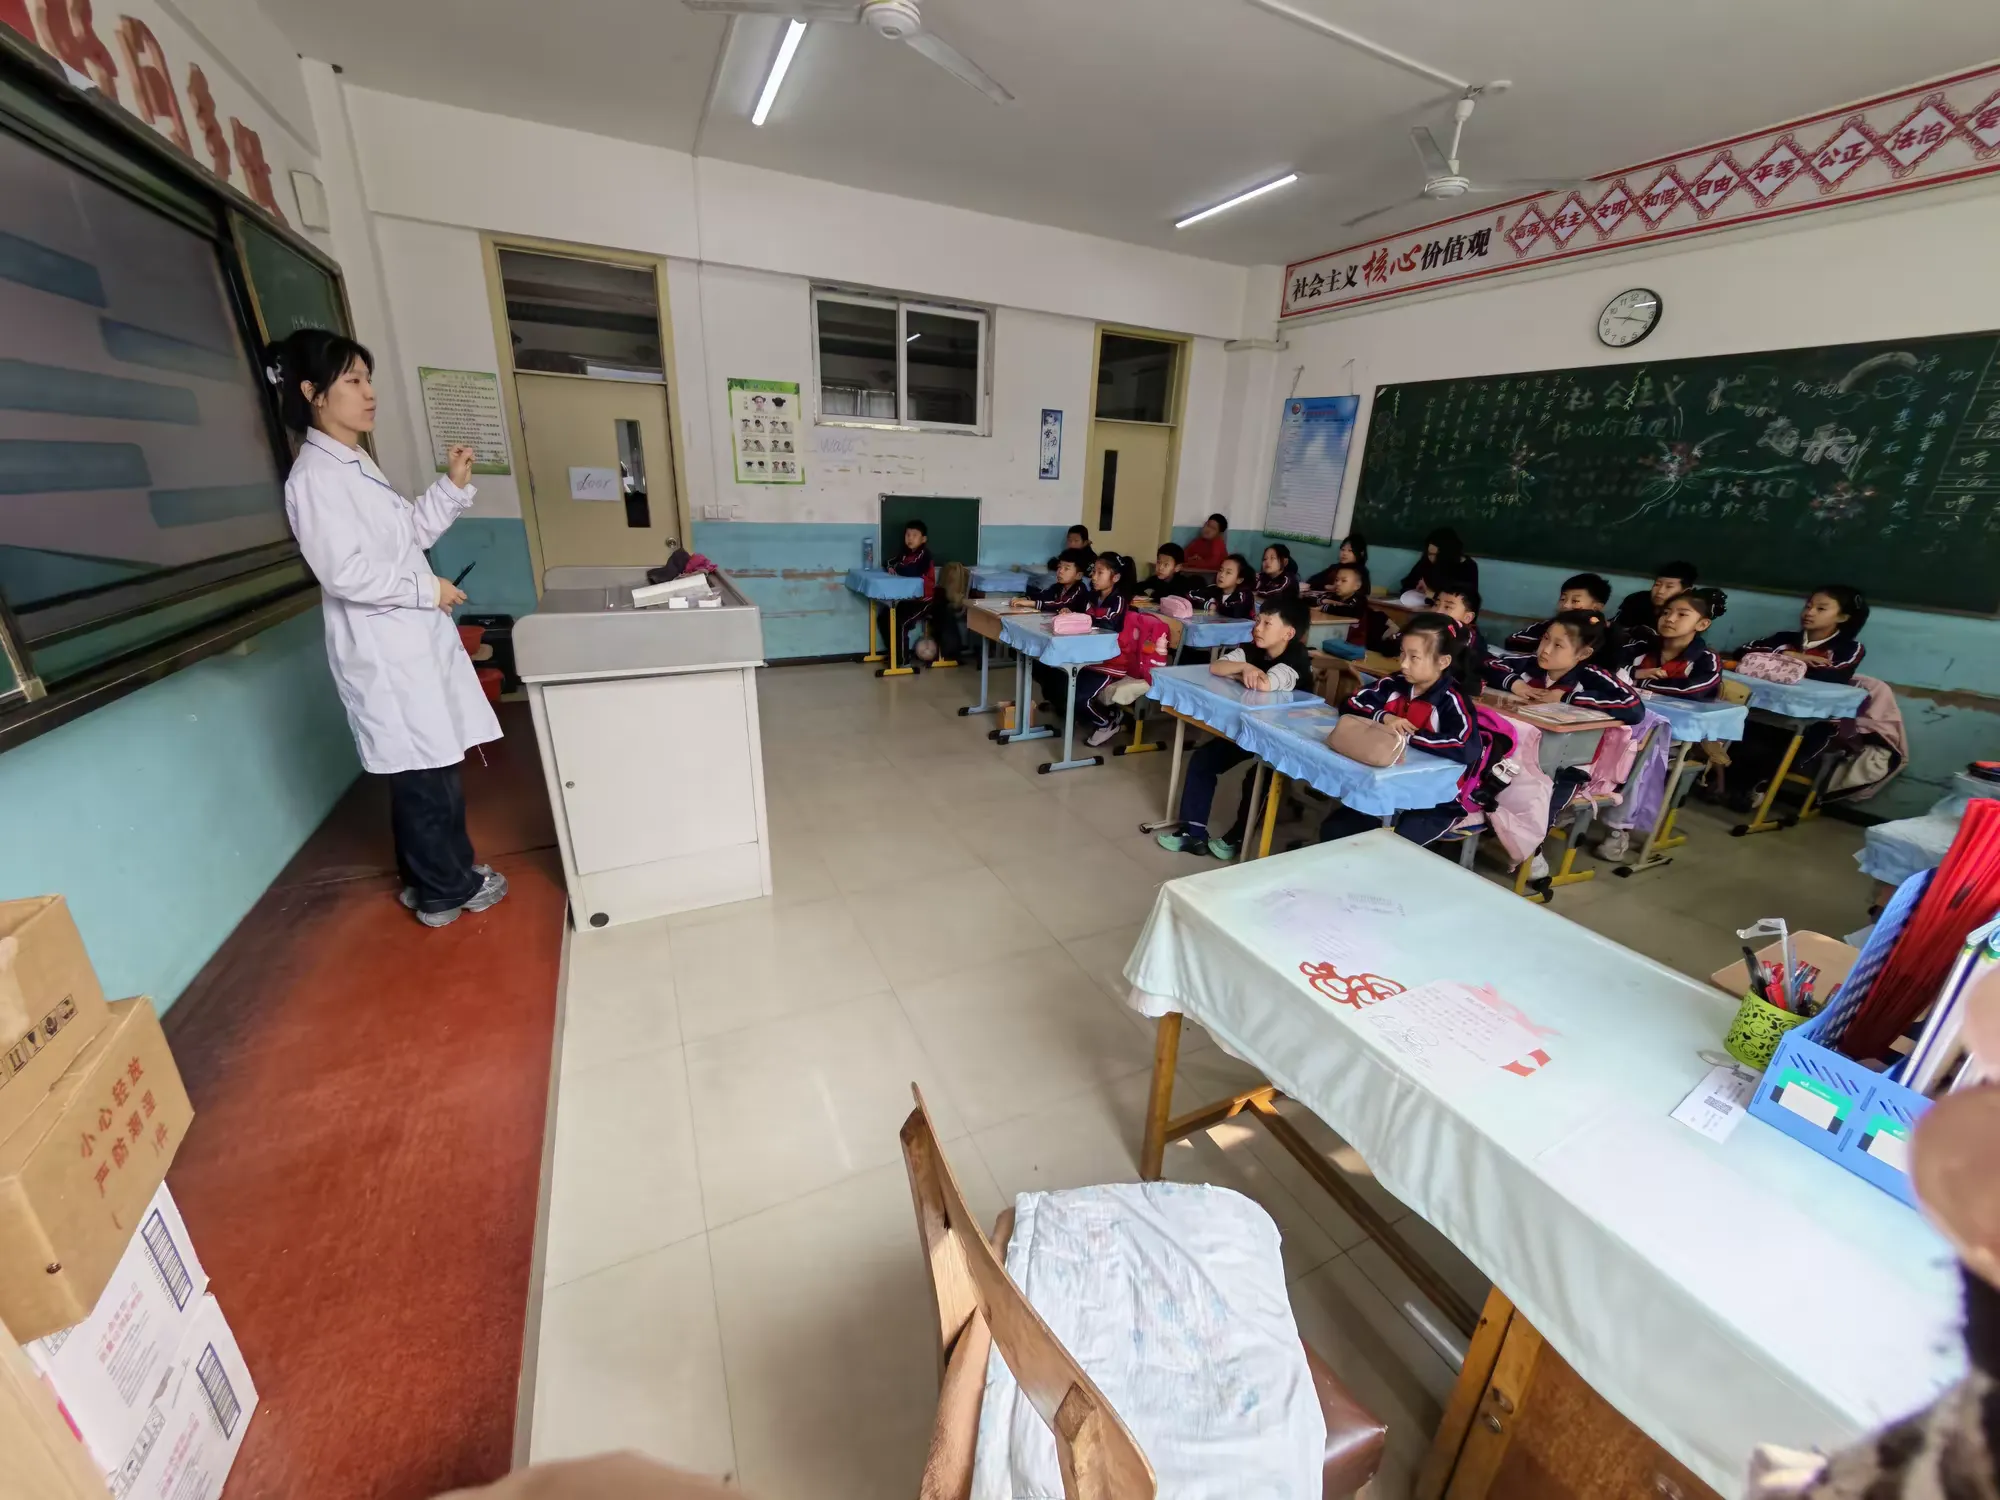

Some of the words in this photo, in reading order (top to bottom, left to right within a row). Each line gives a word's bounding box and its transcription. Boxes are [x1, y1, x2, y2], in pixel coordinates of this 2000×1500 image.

[1552, 211, 1582, 231] 民主
[1597, 199, 1627, 219] 文明
[1695, 173, 1734, 197] 自由
[1753, 158, 1796, 184] 平等
[1818, 141, 1866, 169] 公正
[1893, 121, 1946, 150] 法治
[81, 1056, 145, 1158] 小心轻放
